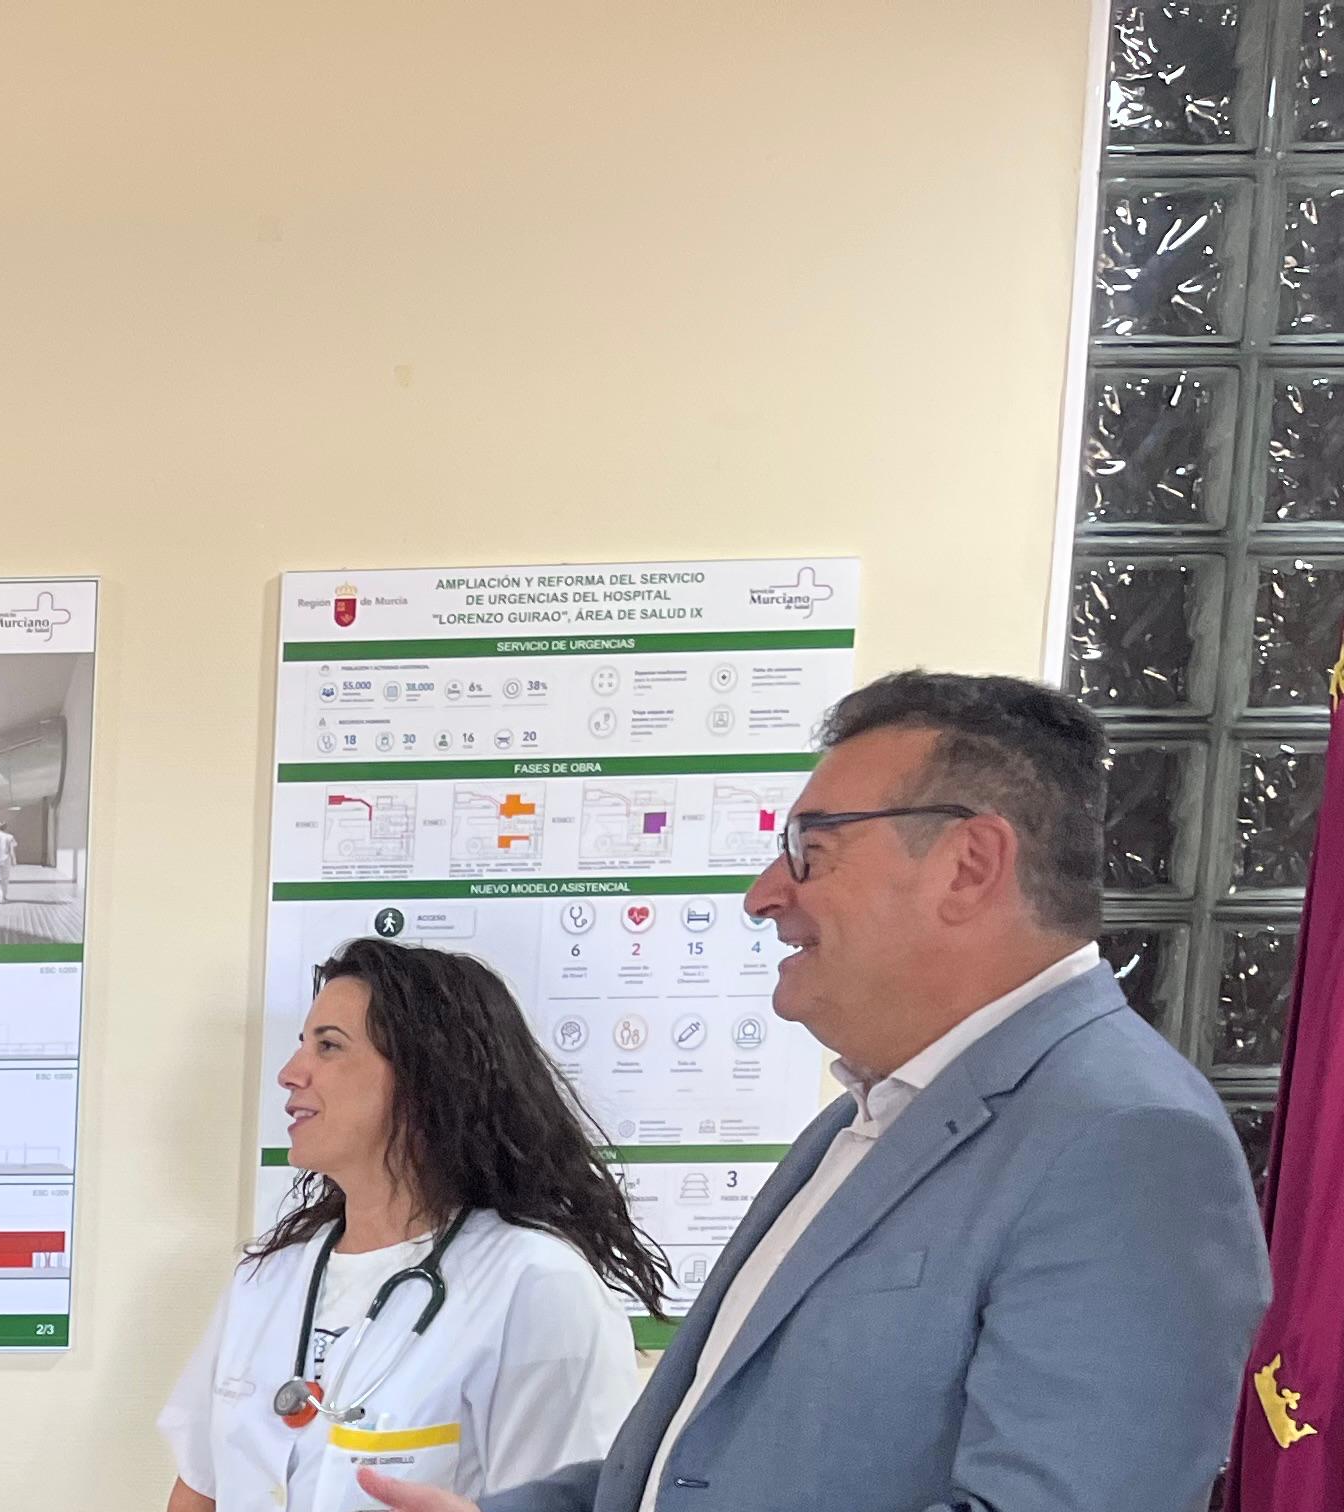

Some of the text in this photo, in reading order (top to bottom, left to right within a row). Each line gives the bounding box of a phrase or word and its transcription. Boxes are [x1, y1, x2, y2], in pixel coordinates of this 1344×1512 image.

[436, 572, 705, 591] AMPLIACIÓN Y REFORMA DEL SERVICIO
[360, 597, 372, 606] de
[375, 596, 408, 606] Murcia
[466, 589, 671, 606] DE URGENCIAS DEL HOSPITAL
[750, 594, 810, 605] Murciano
[432, 612, 503, 625] "LORENZO
[575, 607, 612, 621] ÁREA
[617, 609, 636, 620] DE
[640, 608, 686, 620] SALUD
[690, 607, 703, 618] IX
[496, 638, 635, 652] SERVICIO DE URGENCIAS
[343, 735, 357, 745] 18
[403, 734, 416, 744] 30
[462, 733, 475, 743] 16
[523, 732, 537, 742] 20
[514, 762, 602, 775] FASES DE OBRA
[470, 882, 630, 895] NUEVO MODELO ASISTENCIAL
[570, 944, 581, 957] 6
[631, 942, 641, 956] 2
[687, 941, 704, 955] 15
[750, 941, 762, 953] 4
[727, 1171, 738, 1188] 3
[36, 1323, 55, 1335] 2/3
